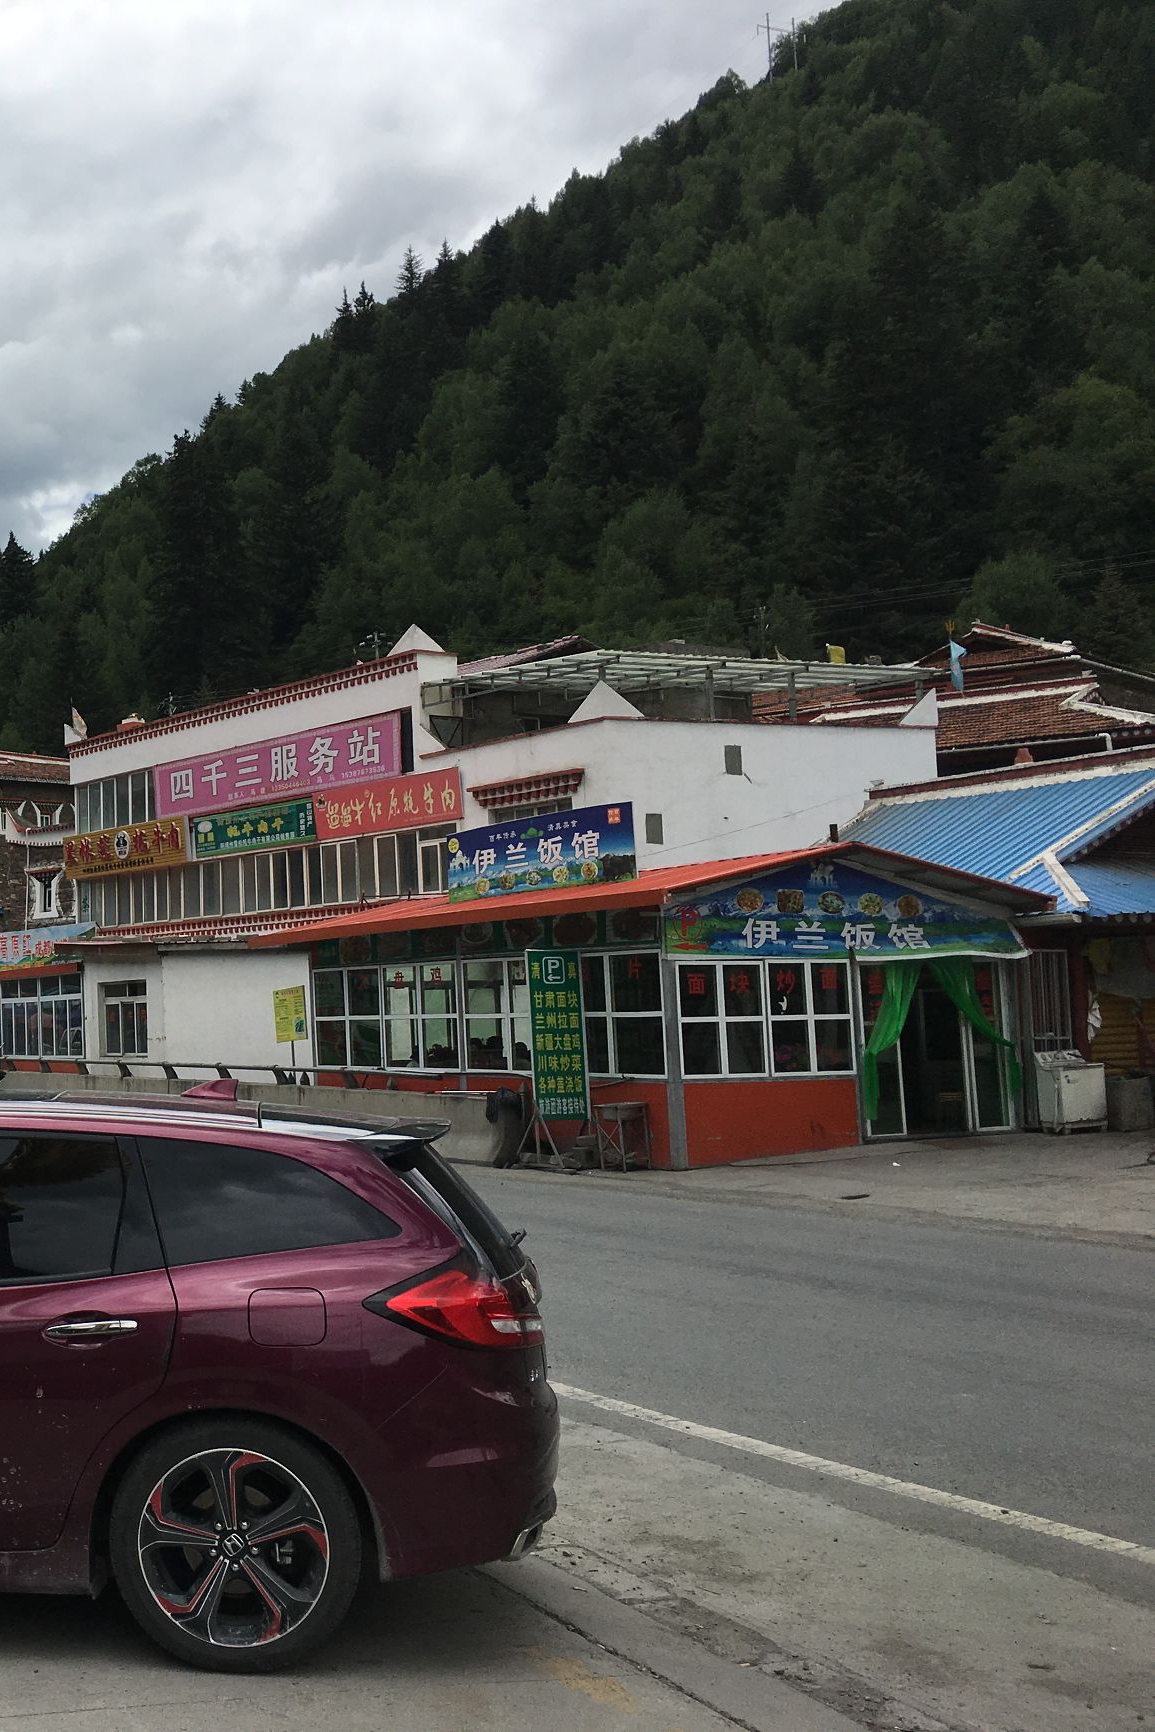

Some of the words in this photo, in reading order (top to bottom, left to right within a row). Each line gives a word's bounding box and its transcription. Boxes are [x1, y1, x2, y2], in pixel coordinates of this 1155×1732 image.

[170, 727, 381, 802] 四千三服务站
[472, 830, 601, 875] 伊兰饭馆
[742, 918, 932, 951] 伊兰饭馆
[534, 991, 578, 1008] 甘肃面块
[535, 1012, 580, 1030] 兰州拉面
[536, 1033, 581, 1050] 新疆大盘鸡
[538, 1055, 582, 1072] 川味炒菜
